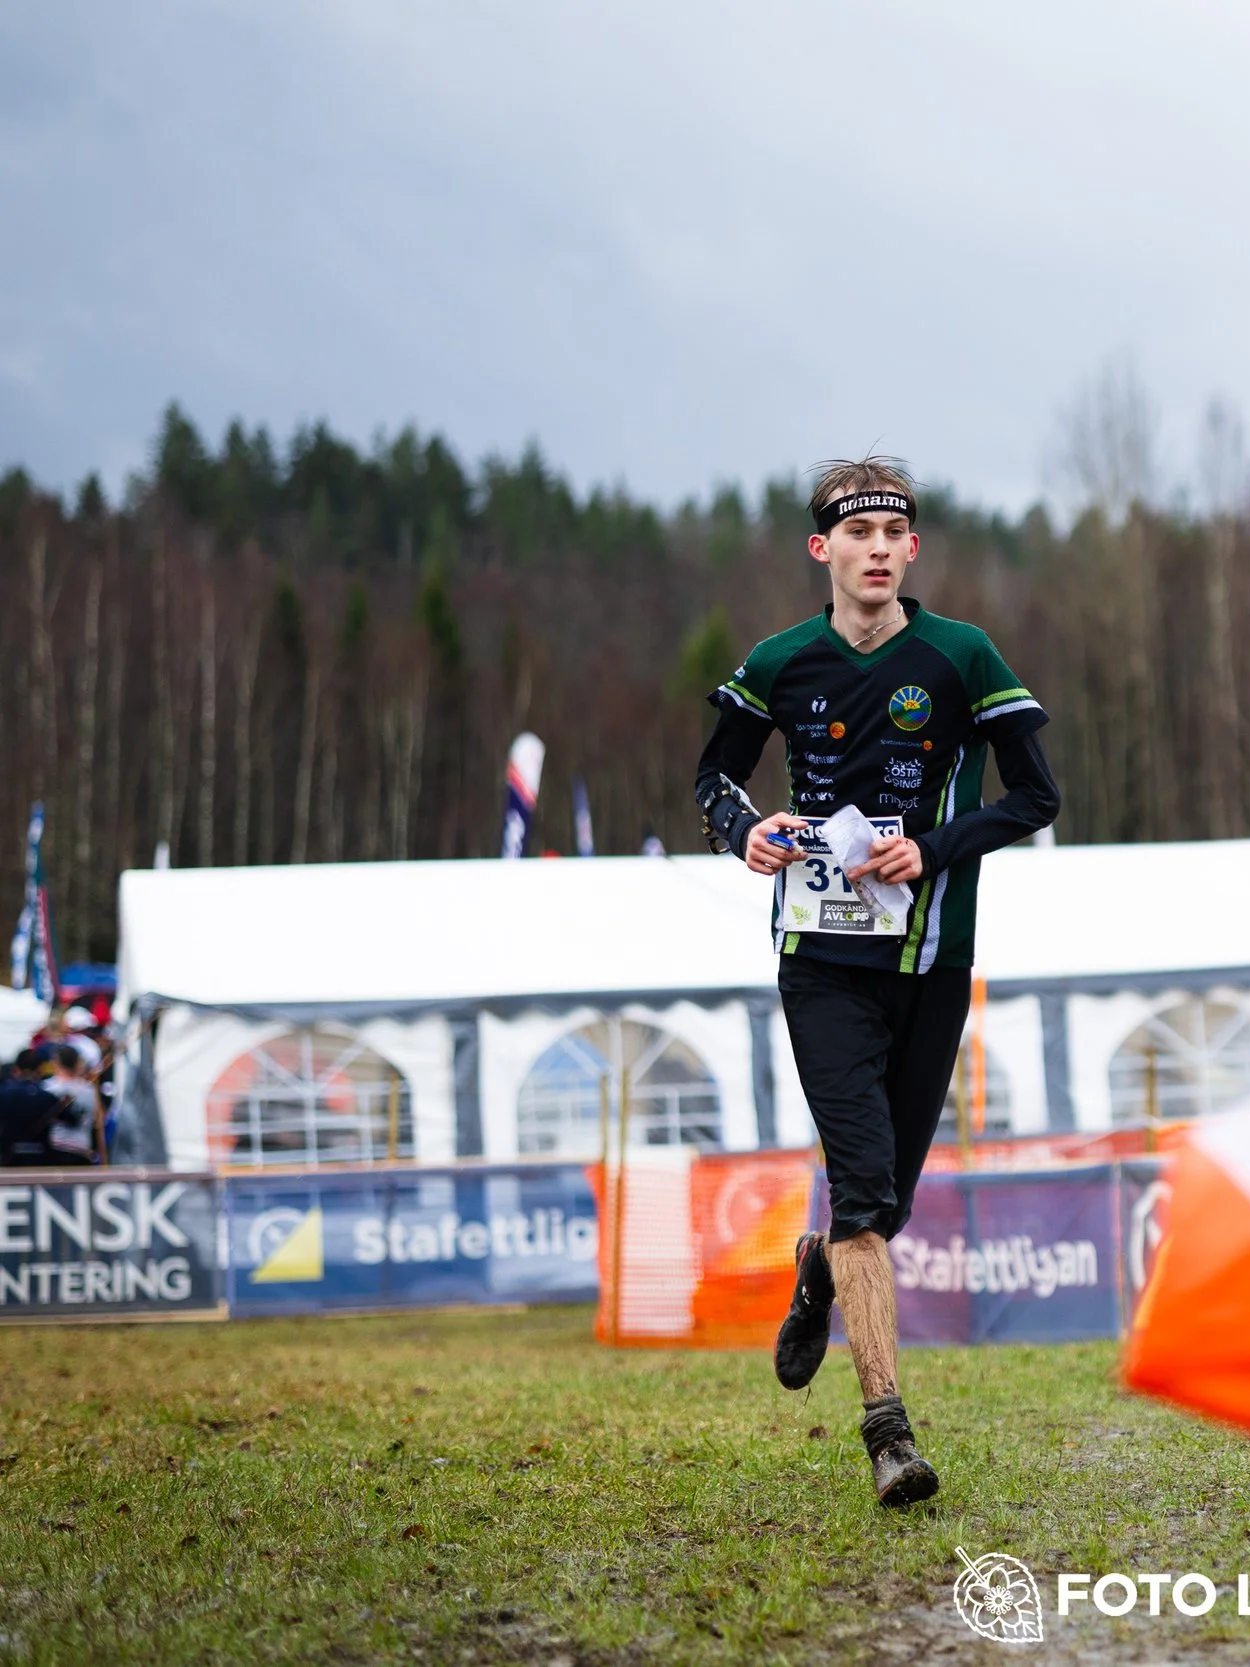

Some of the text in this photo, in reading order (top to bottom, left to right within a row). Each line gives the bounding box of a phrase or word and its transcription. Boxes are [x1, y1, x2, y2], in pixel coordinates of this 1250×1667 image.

[824, 912, 870, 922] AVLOPP
[0, 1182, 189, 1252] ENSK
[353, 1208, 598, 1265] Stafettlig
[0, 1256, 191, 1304] NTERING
[890, 1234, 1098, 1298] Stafettligan
